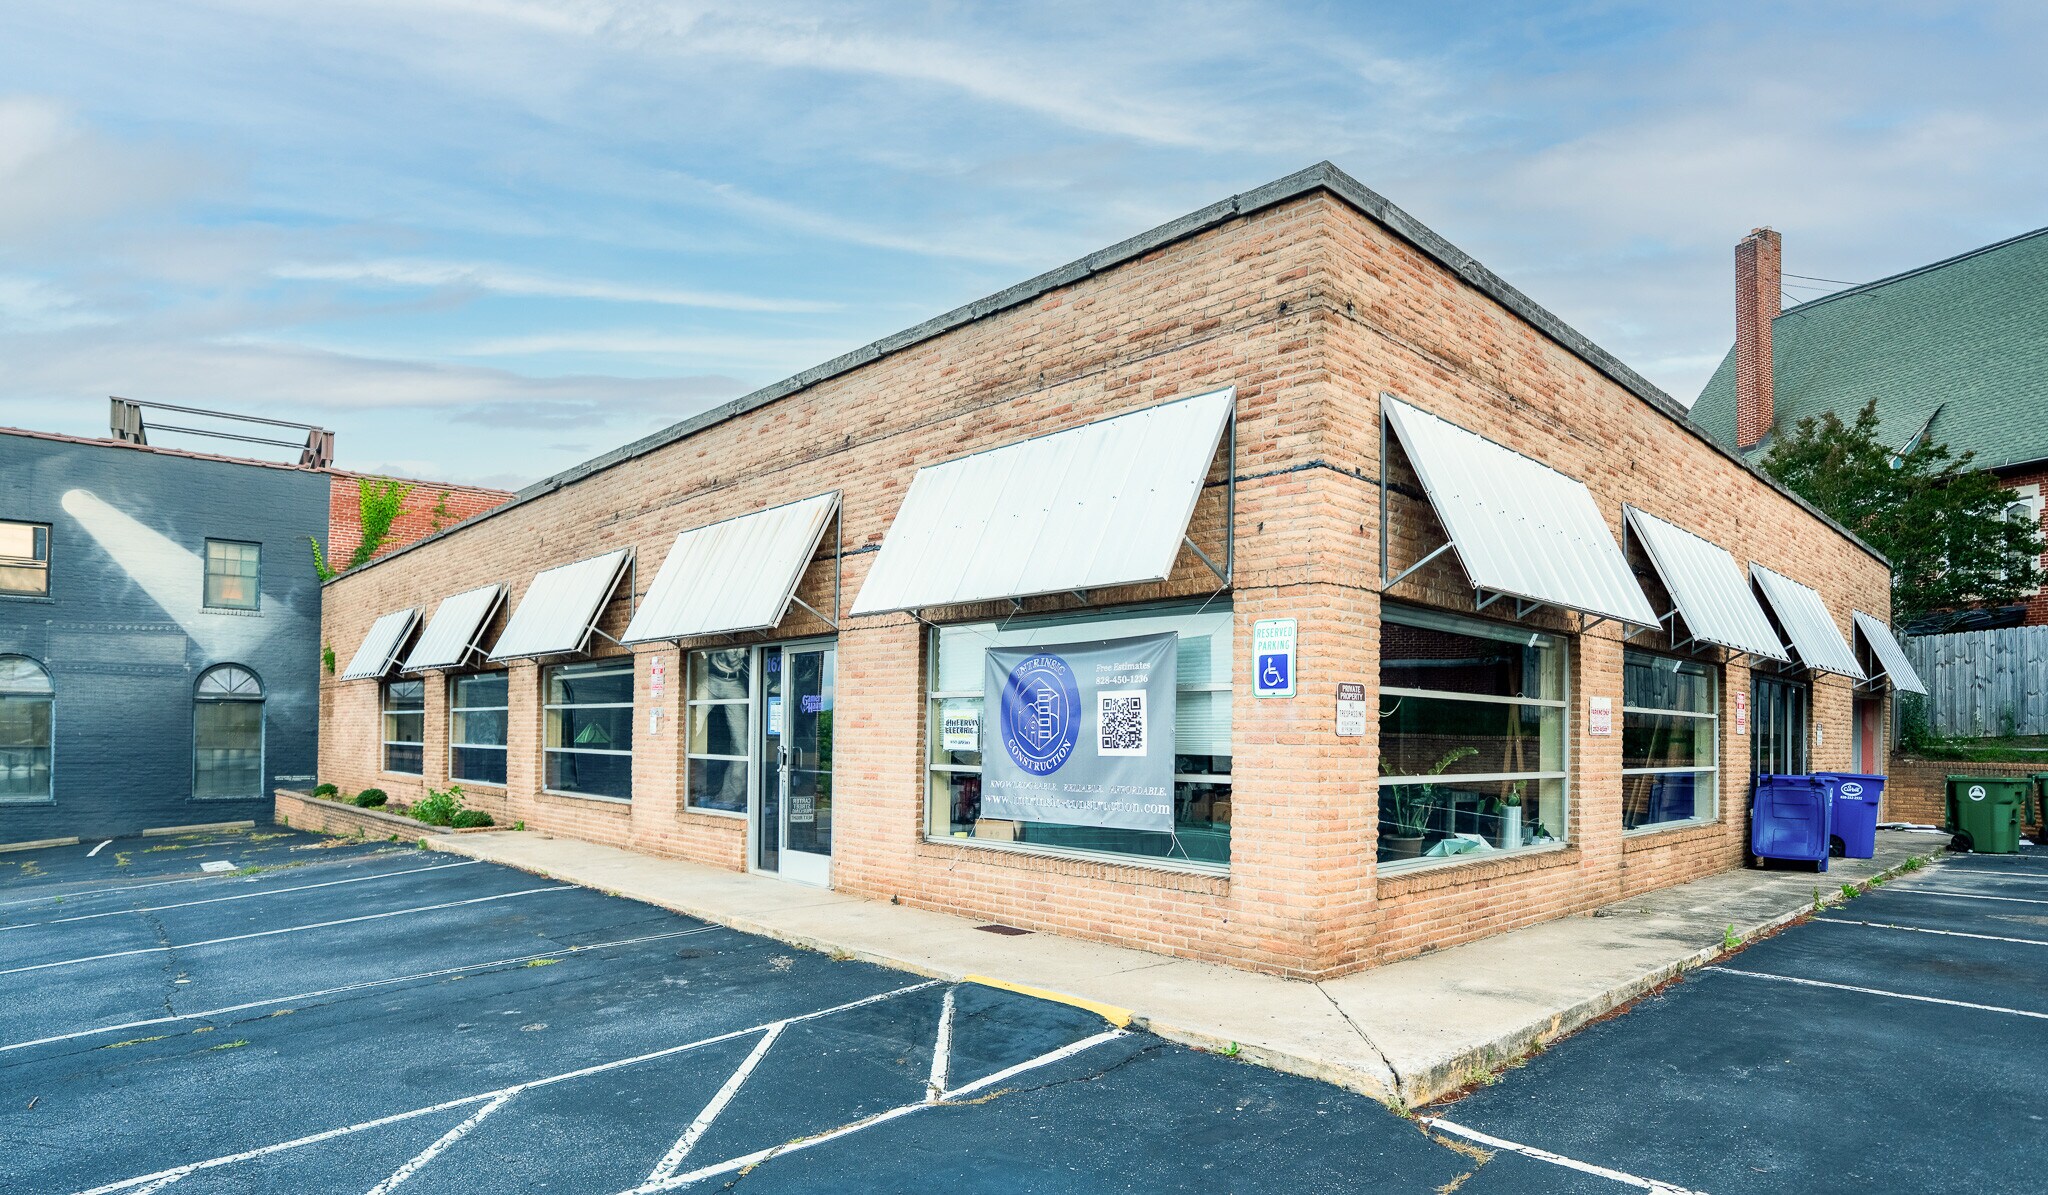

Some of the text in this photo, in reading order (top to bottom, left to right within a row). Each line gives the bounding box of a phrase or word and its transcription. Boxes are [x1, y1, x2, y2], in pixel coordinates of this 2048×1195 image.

[1257, 627, 1293, 638] RESERVED
[1258, 640, 1290, 651] PARKING
[1016, 658, 1067, 678] INTRINSIC
[1095, 661, 1151, 672] Free Estimates
[1095, 674, 1149, 685] 828-450-1236
[1341, 684, 1361, 694] PRIVATE
[1340, 692, 1364, 701] PROPERTY
[1008, 739, 1072, 771] CONSTRUCTION
